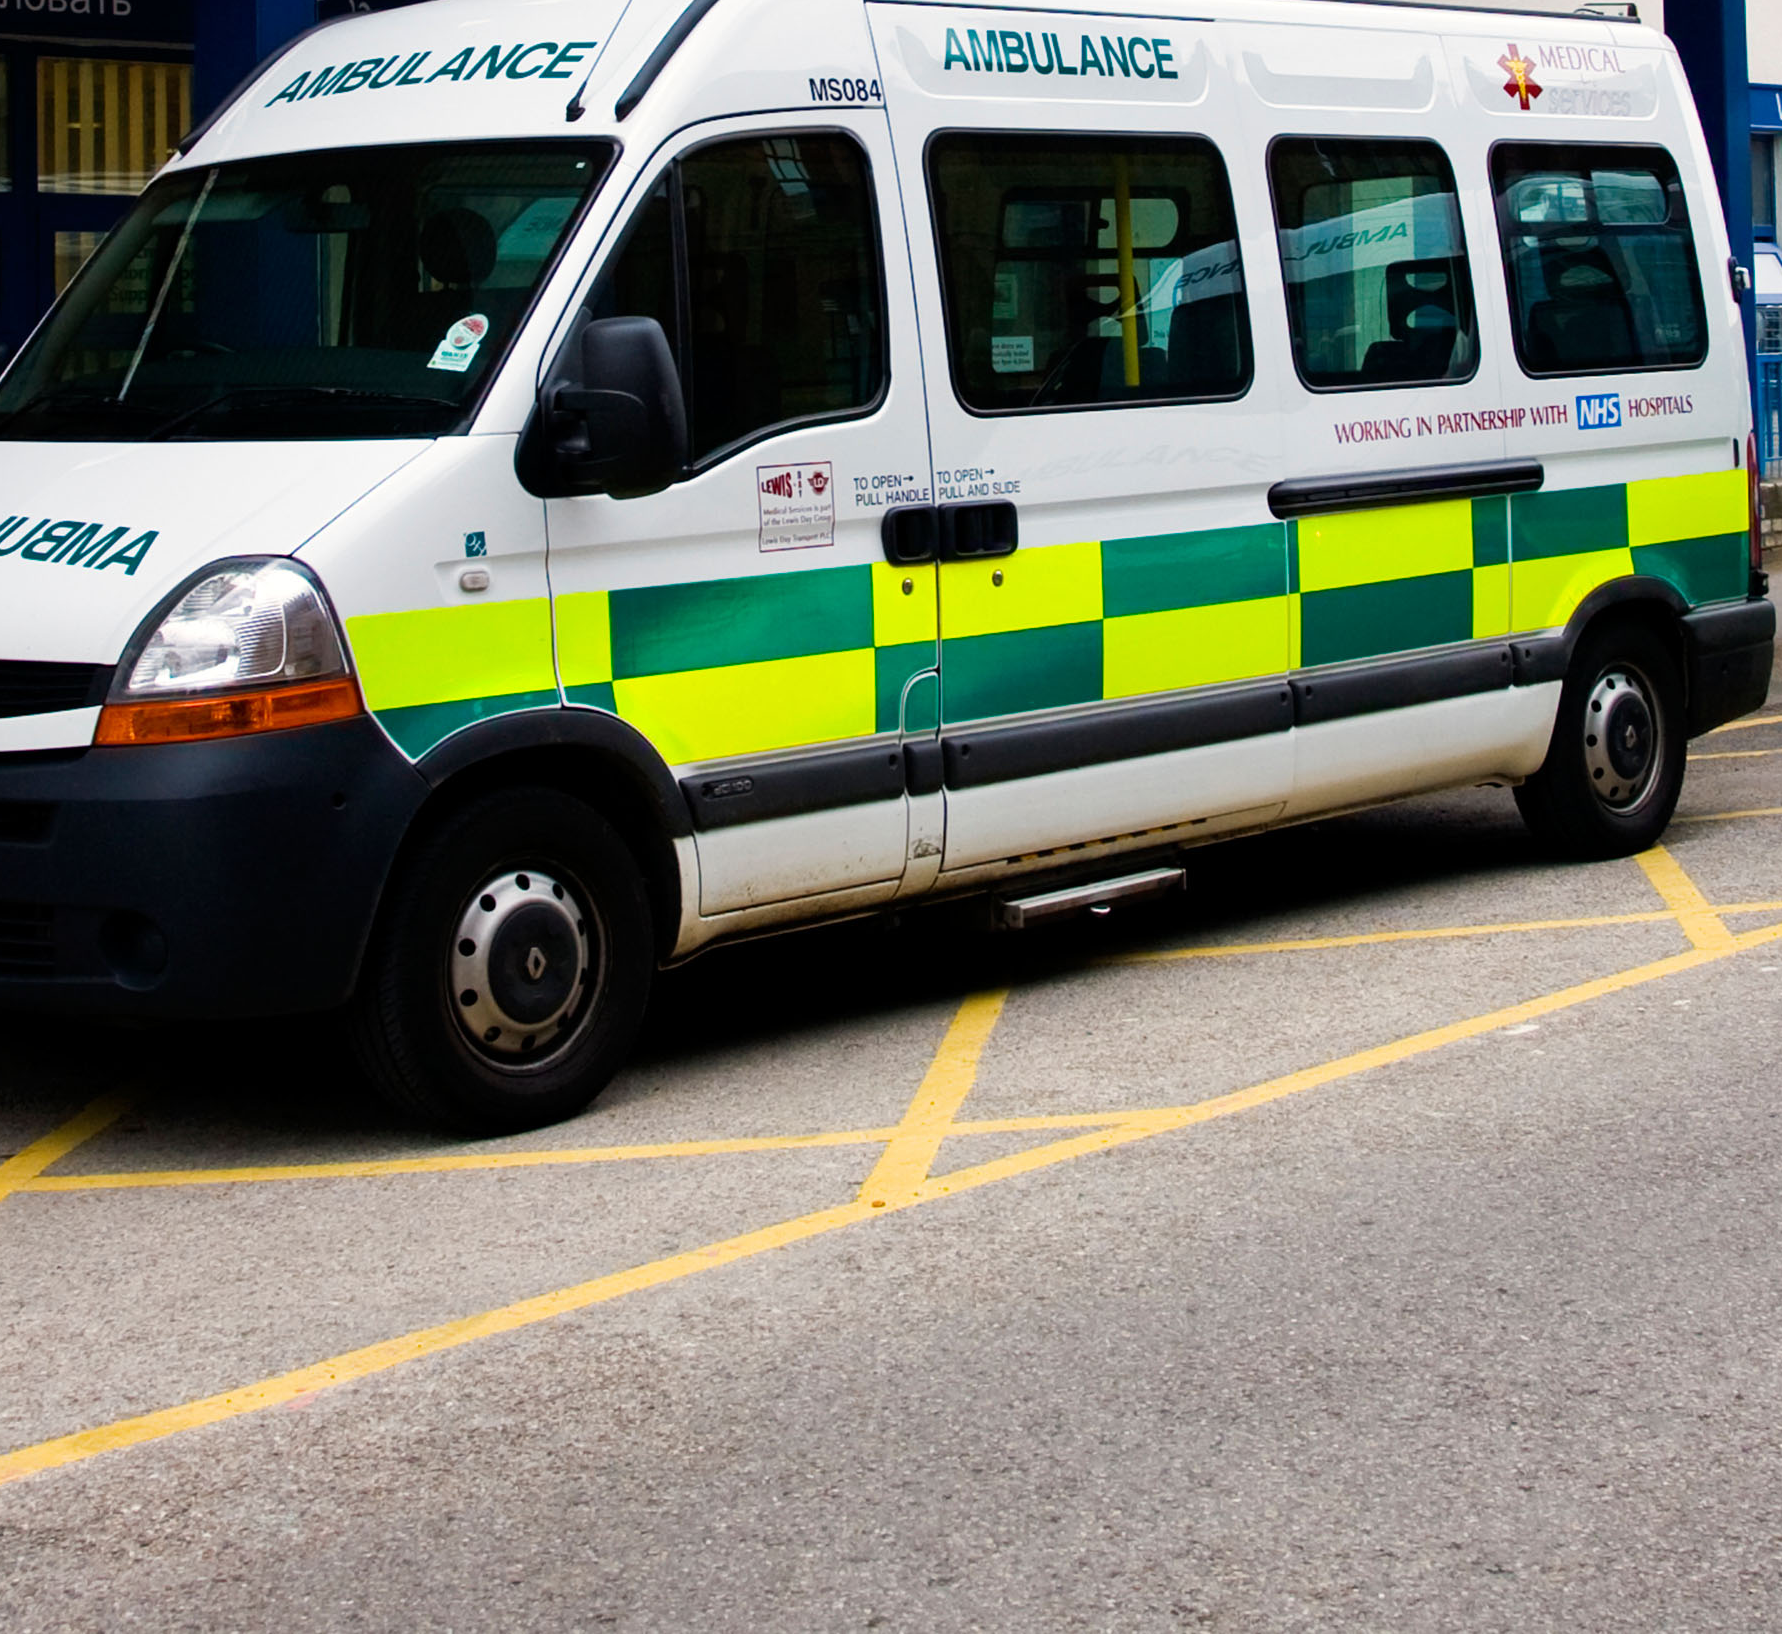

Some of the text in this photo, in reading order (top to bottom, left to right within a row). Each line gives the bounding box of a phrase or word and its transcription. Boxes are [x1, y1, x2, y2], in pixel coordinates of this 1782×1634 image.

[944, 27, 1178, 80] AMBULANCE
[1538, 44, 1626, 73] MEDICAL
[265, 41, 598, 108] AMBULANCE
[809, 77, 882, 103] MS084
[1334, 395, 1693, 444] WORKING IN PARTNERSHIP WITH NHS HOSPITALS
[761, 471, 793, 498] LEWIS
[854, 475, 902, 490] TO OPEN
[936, 469, 983, 484] TO OPEN
[855, 488, 930, 507] PULL HANDLE
[939, 480, 1021, 500] PULL AND SLIDE
